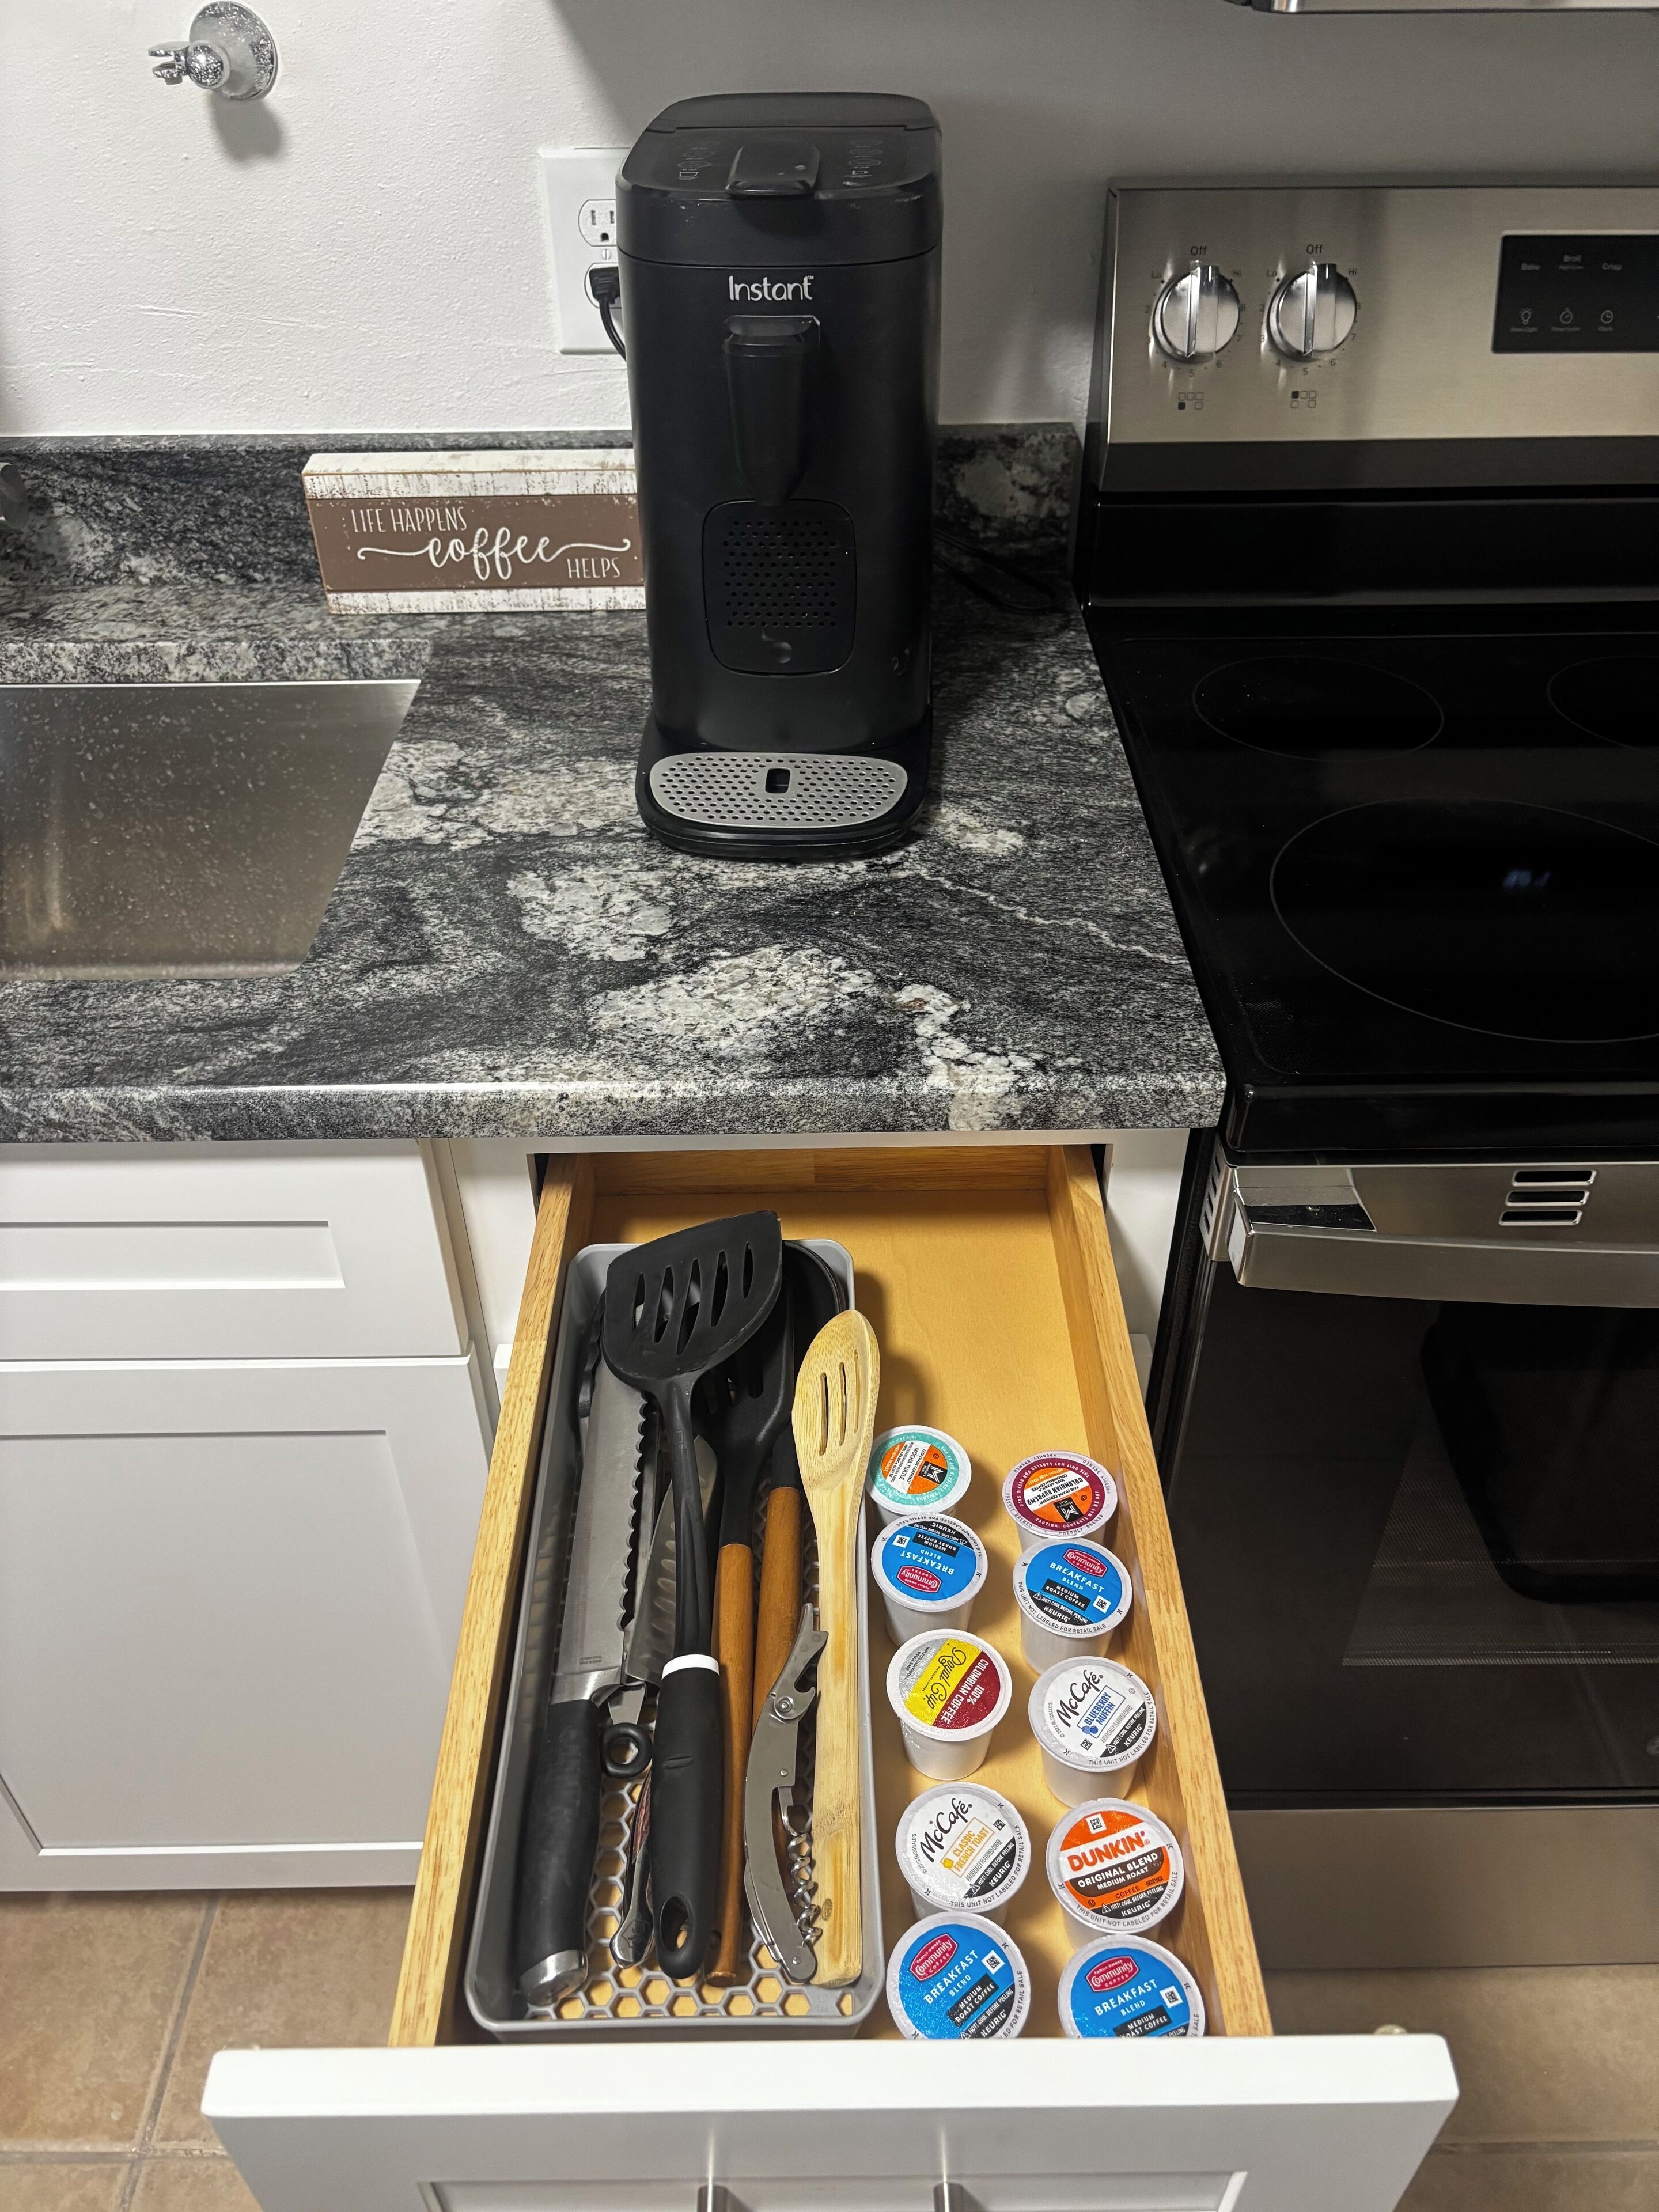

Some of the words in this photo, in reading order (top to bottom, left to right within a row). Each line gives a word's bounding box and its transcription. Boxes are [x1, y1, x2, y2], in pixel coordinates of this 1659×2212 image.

[1191, 246, 1206, 256] Off
[1306, 245, 1323, 254] Off
[351, 508, 386, 532] LIFE
[389, 507, 467, 532] HAPPENS
[392, 527, 595, 581] coffee
[567, 558, 620, 579] HELPS
[908, 1447, 918, 1464] MOCHA
[899, 1464, 910, 1480] TURTLE
[1046, 1474, 1067, 1484] COLOMBIAN
[1080, 1469, 1090, 1478] THIS
[1032, 1483, 1046, 1491] COFFEE
[1038, 1483, 1055, 1492] ARABICA
[1052, 1477, 1082, 1493] COLOMBIAN
[1027, 1490, 1052, 1505] SUPREMO
[1005, 1493, 1015, 1513] FRESHLY
[1014, 1514, 1032, 1528] BREWED
[1063, 1517, 1088, 1528] CONTENTS
[1088, 1509, 1096, 1517] MAY
[917, 1534, 937, 1543] COFFEE
[930, 1522, 956, 1535] KEURIG
[920, 1549, 941, 1560] BLEND
[923, 1540, 946, 1551] MEDIUM
[938, 1541, 957, 1550] ROAST
[899, 1551, 955, 1574] BREAKFAST
[911, 1569, 933, 1578] COFFEE
[1067, 1552, 1104, 1574] Community
[900, 1569, 938, 1588] Community
[1050, 1562, 1104, 1593] BREAKFAST
[1062, 1578, 1083, 1590] BLEND
[1045, 1586, 1064, 1597] ROAST
[1065, 1594, 1085, 1608] COFFEE
[1056, 1585, 1079, 1599] MEDIUM
[1020, 1594, 1029, 1605] UNIT
[1028, 1605, 1037, 1614] NOT
[1036, 1613, 1059, 1628] LABELED
[1093, 1623, 1107, 1631] SALE
[1043, 1606, 1070, 1622] KEURIG
[938, 1647, 967, 1687] Royal
[959, 1658, 989, 1695] COLOMBIAN
[927, 1683, 947, 1710] Cup
[967, 1685, 985, 1705] 100%
[941, 1697, 964, 1725] COFFEE
[1084, 1692, 1111, 1725] BLUEBERRY
[1096, 1702, 1116, 1725] MUFFIN
[1112, 1736, 1122, 1745] HOT!
[1119, 1728, 1127, 1738] COOL
[1125, 1718, 1136, 1730] BEFORE
[1134, 1707, 1145, 1719] PEELING
[1119, 1755, 1130, 1763] NOT
[1131, 1736, 1149, 1755] LABELED
[1144, 1692, 1153, 1705] SALE
[1123, 1725, 1142, 1747] KEURIG
[953, 1831, 976, 1857] CLASSIC
[953, 1846, 976, 1871] FRENCH
[972, 1828, 989, 1847] TOAST
[977, 1875, 987, 1885] HOT!
[984, 1866, 994, 1876] COOL
[991, 1854, 1004, 1868] BEFORE
[1001, 1842, 1014, 1856] PEELING
[983, 1895, 995, 1904] NOT
[997, 1876, 1016, 1897] LABELED
[1014, 1825, 1023, 1839] SALE
[989, 1862, 1011, 1887] KEURIG
[1078, 1867, 1126, 1888] ORIGINAL
[1127, 1853, 1158, 1869] BLEND
[1097, 1877, 1126, 1890] MEDIUM
[1126, 1867, 1148, 1880] ROAST
[1115, 1885, 1139, 1899] COFFEE
[1121, 1898, 1132, 1907] COOL
[1132, 1893, 1146, 1902] BEFORE
[1146, 1886, 1164, 1896] PEELING
[1076, 1905, 1089, 1916] THIS
[1090, 1915, 1105, 1924] UNIT
[1122, 1915, 1150, 1926] LABELED
[1150, 1906, 1161, 1917] FOR
[1161, 1889, 1174, 1907] RETAIL
[1121, 1900, 1150, 1916] KEURIG
[915, 1939, 952, 1976] Community
[1108, 1960, 1123, 1968] OWNED
[924, 1950, 979, 2004] BREAKFAST
[1091, 1961, 1134, 1987] Community
[1105, 1974, 1128, 1987] COFFEE
[950, 1975, 971, 1997] BLEND
[955, 2003, 974, 2022] ROAST
[974, 1983, 994, 2004] COFFEE
[959, 1986, 982, 2009] MEDIUM
[1094, 1979, 1158, 2016] BREAKFAST
[1121, 2000, 1146, 2016] BLEND
[968, 2022, 979, 2034] HOT!
[978, 2013, 988, 2025] COOL
[986, 2001, 1000, 2016] BEFORE
[998, 1988, 1013, 2004] PEELING
[1010, 2014, 1018, 2028] FOR
[1016, 1990, 1025, 2013] RETAIL
[981, 2010, 1006, 2037] KEURIG
[1128, 2014, 1154, 2029] MEDIUM
[1144, 2016, 1168, 2030] COFFEE
